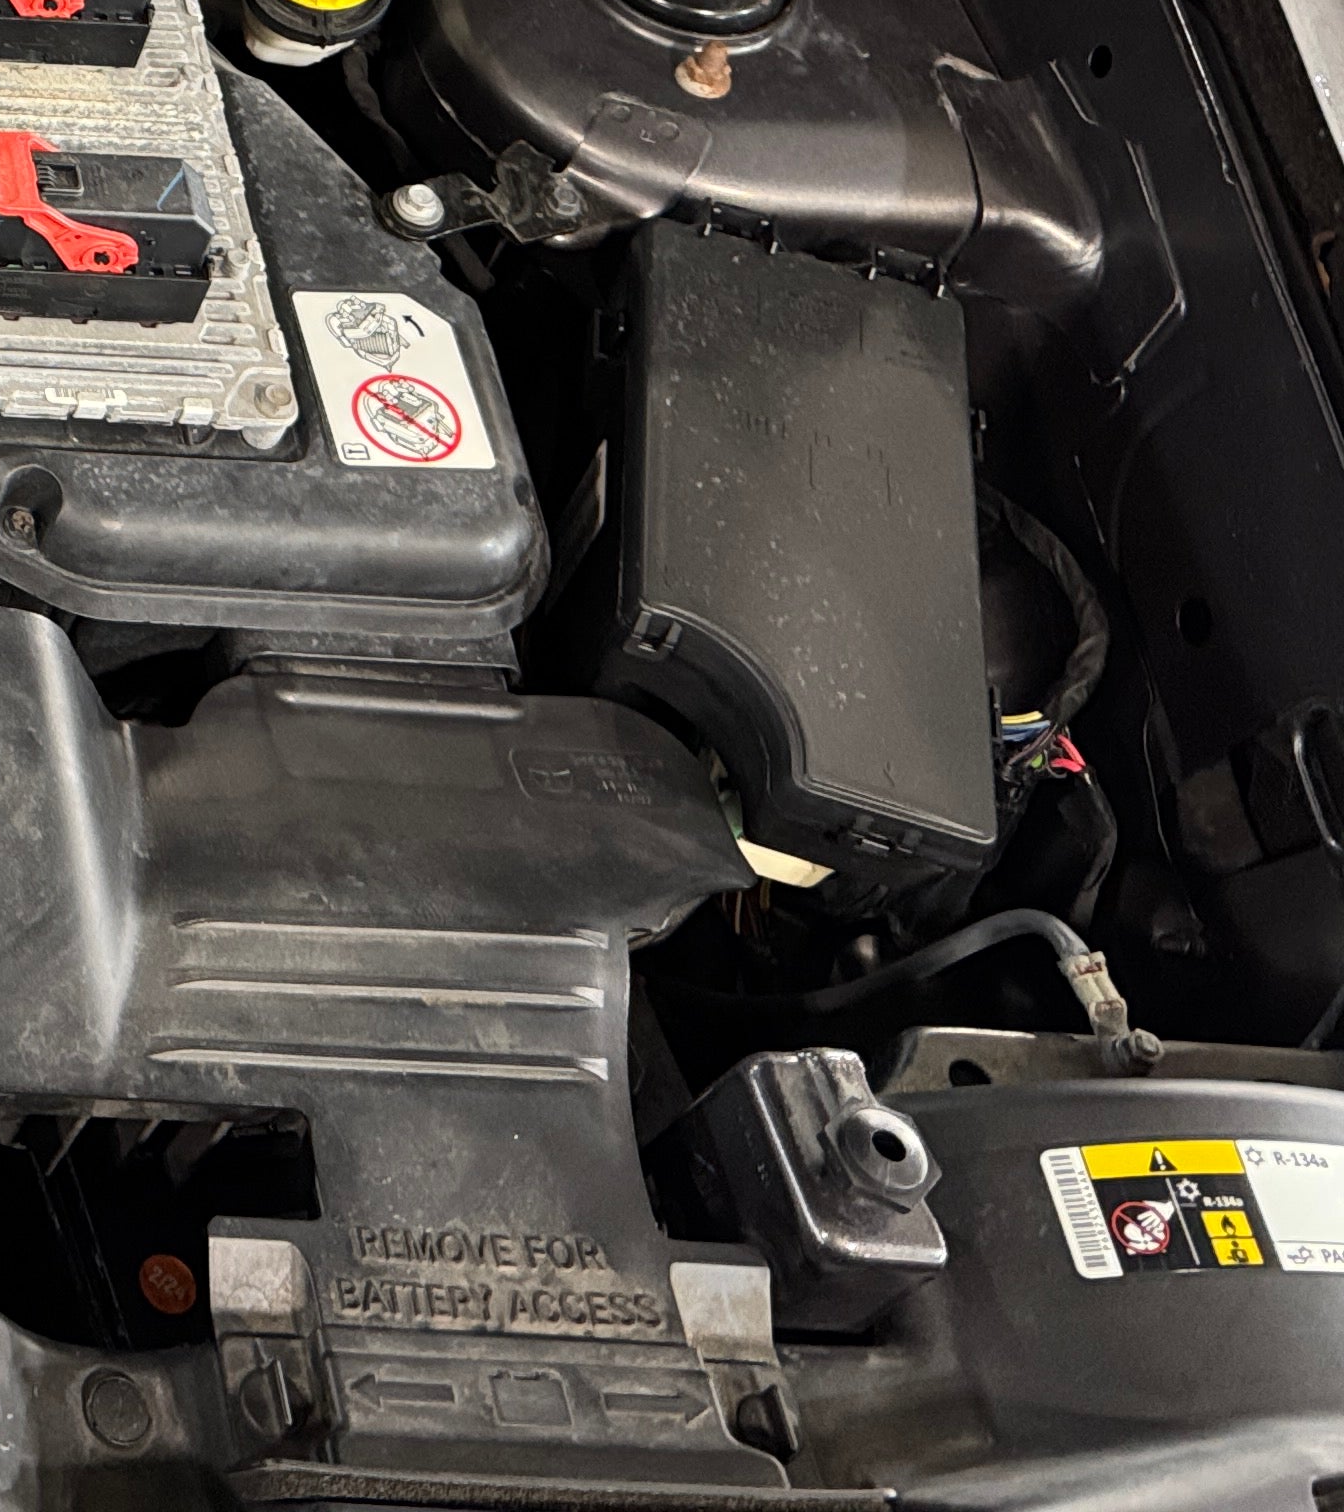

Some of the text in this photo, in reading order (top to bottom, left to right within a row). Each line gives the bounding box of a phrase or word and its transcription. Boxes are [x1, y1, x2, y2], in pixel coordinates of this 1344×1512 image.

[1273, 1149, 1330, 1170] R-134a
[352, 1226, 610, 1272] REMOVE FOR
[335, 1279, 664, 1328] BATTERY ACCESS
